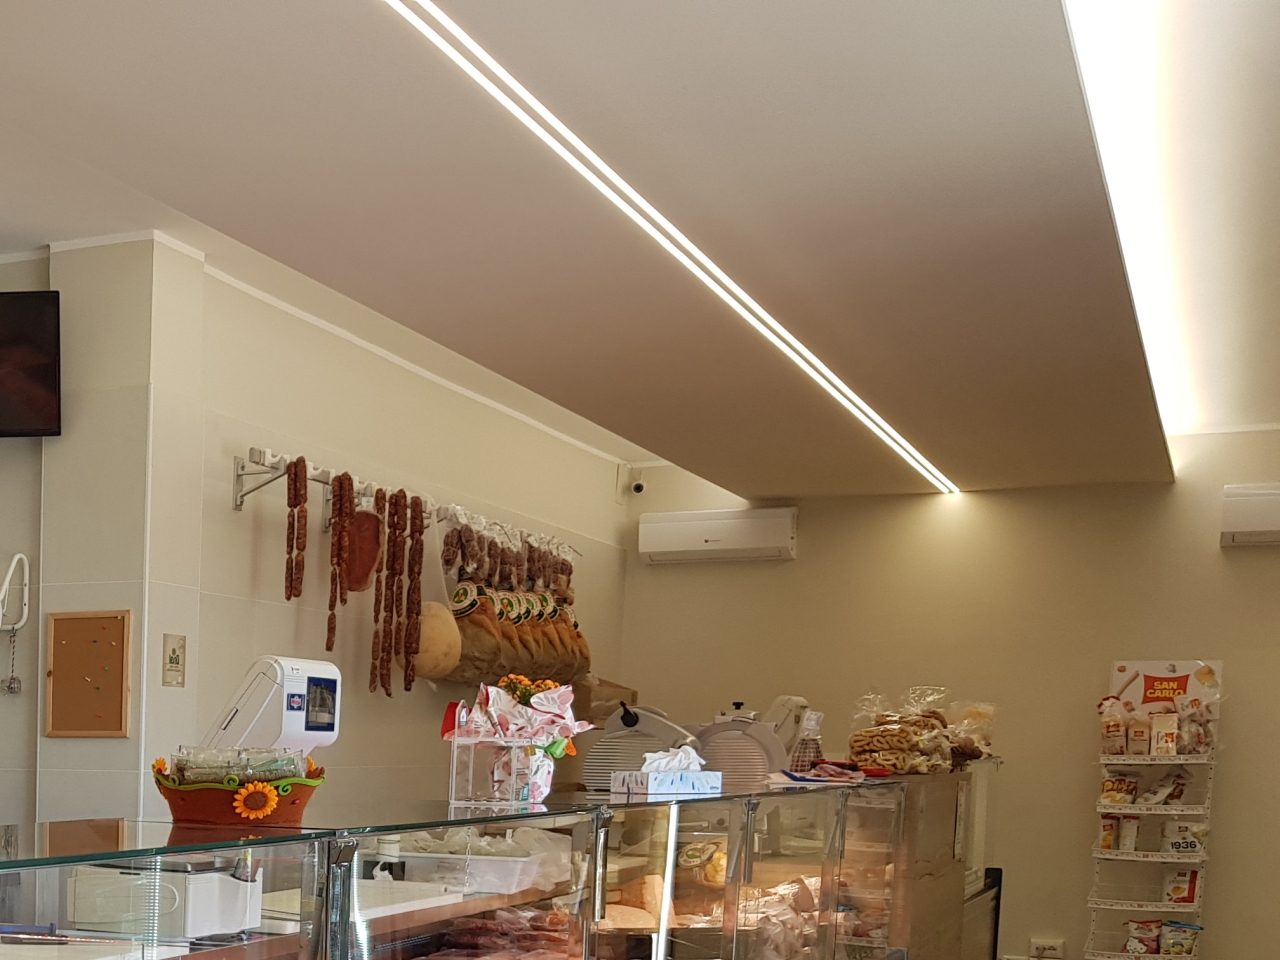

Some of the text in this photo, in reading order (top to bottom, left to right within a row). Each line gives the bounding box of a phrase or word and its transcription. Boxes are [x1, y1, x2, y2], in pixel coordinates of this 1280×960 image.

[1153, 681, 1179, 690] SAN
[1146, 689, 1184, 698] CARLO
[1170, 840, 1197, 850] 1936
